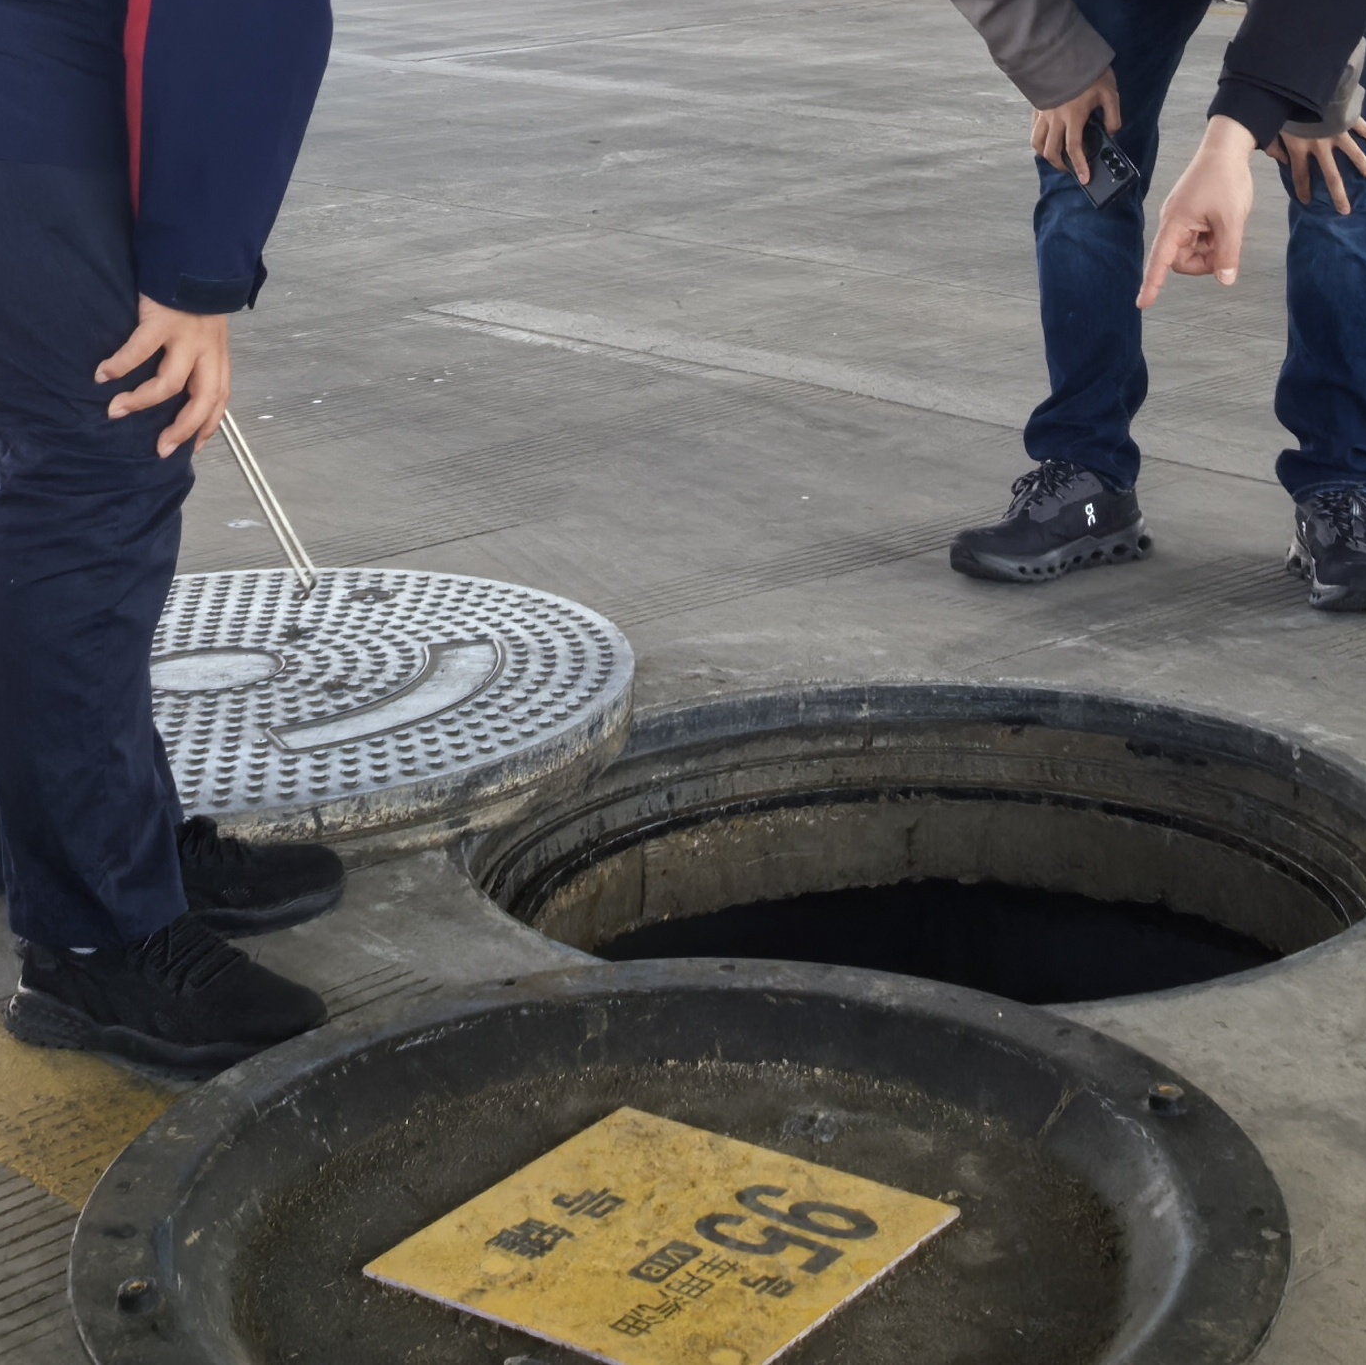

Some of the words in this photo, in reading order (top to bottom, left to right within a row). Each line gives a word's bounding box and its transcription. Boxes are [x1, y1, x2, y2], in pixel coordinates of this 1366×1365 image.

[695, 1184, 878, 1275] 95
[609, 1253, 739, 1337] 车用汽油
